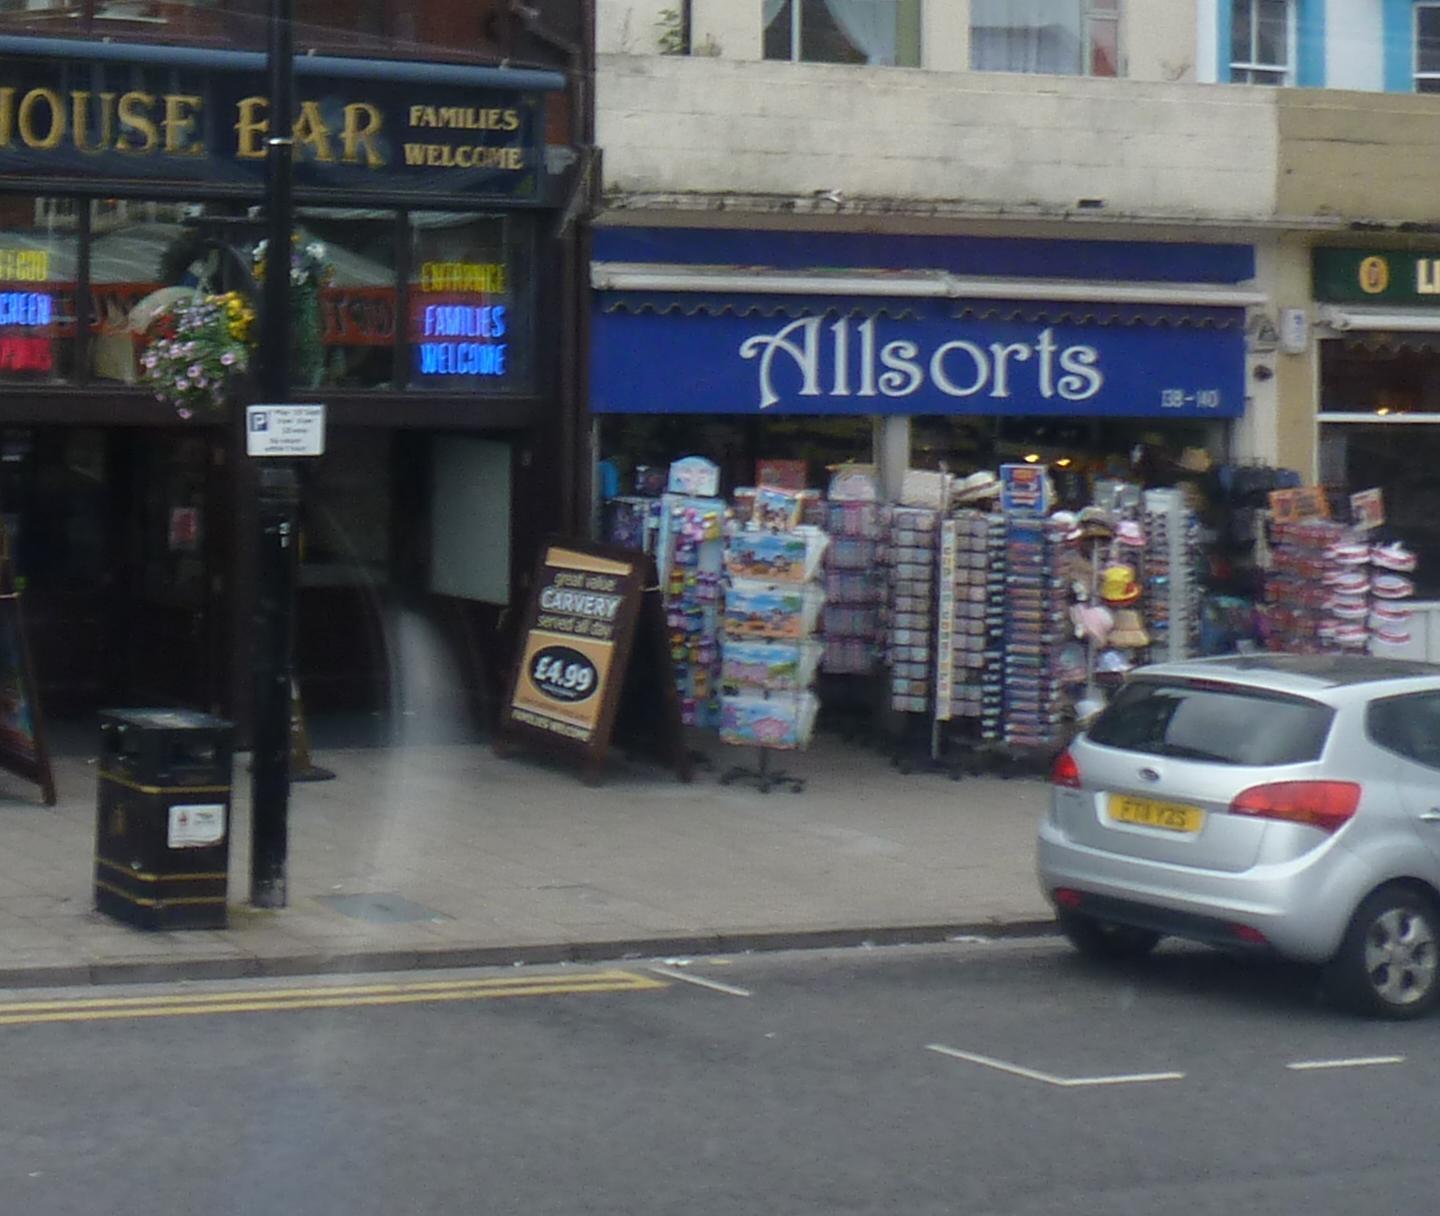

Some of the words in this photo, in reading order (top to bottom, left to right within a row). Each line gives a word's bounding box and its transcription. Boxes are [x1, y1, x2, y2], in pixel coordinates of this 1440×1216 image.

[409, 105, 520, 131] FAMILIES
[403, 143, 524, 170] WELCOME
[423, 304, 507, 338] FAMILIES
[419, 342, 507, 376] WELCOME
[739, 316, 1105, 409] Allsorts
[540, 588, 623, 619] CARVERY
[533, 655, 594, 692] £4.99
